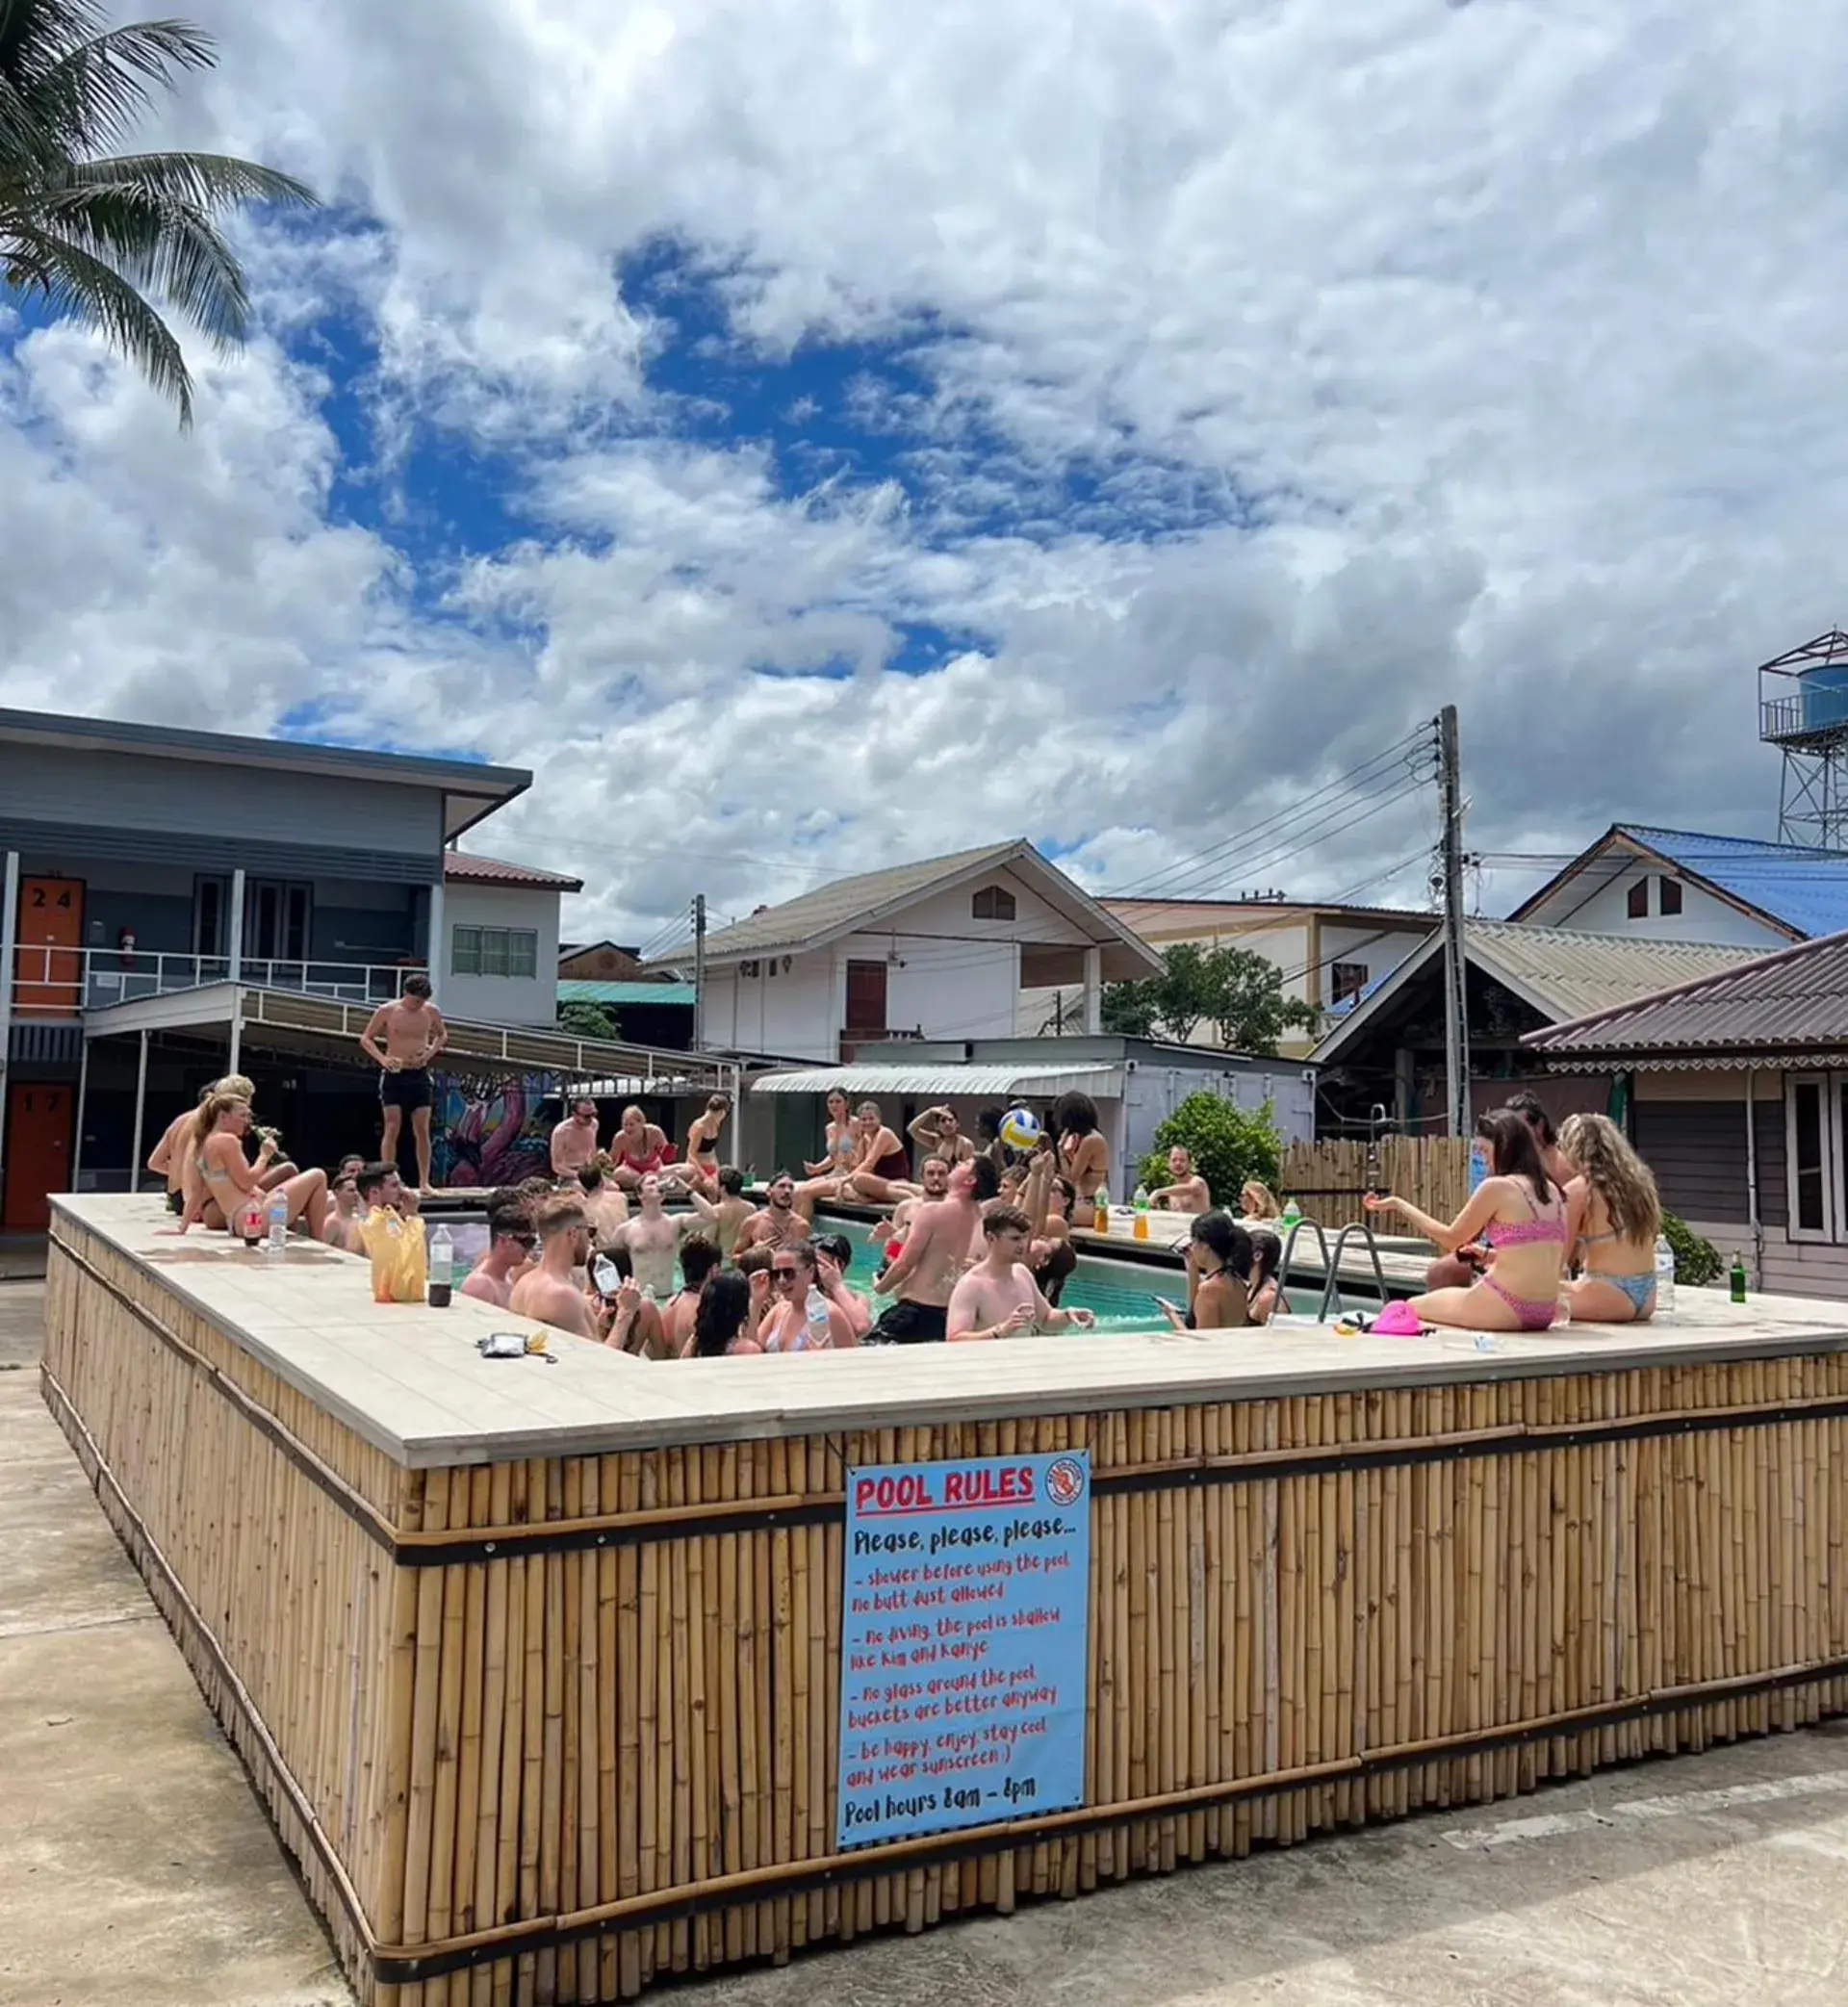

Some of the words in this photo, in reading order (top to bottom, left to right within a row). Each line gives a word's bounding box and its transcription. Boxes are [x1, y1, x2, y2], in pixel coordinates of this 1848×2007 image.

[856, 1474, 933, 1510] POOL
[944, 1466, 1034, 1504] RULES
[855, 1530, 925, 1556] Please,
[930, 1524, 998, 1556] please,
[1003, 1517, 1076, 1548] please...
[868, 1565, 916, 1587] shower
[922, 1562, 974, 1581] before
[977, 1558, 1013, 1579] using
[1015, 1555, 1040, 1573] the
[852, 1597, 870, 1613] no
[873, 1589, 909, 1611] butt
[913, 1585, 946, 1607] dust
[950, 1582, 1005, 1603] allowed
[865, 1629, 883, 1644] no
[937, 1617, 962, 1636] the
[966, 1614, 992, 1636] pool
[995, 1614, 1007, 1628] is
[1012, 1607, 1060, 1626] shallow
[849, 1654, 876, 1671] like
[911, 1646, 937, 1665] and
[862, 1685, 880, 1702] no
[885, 1682, 922, 1704] glass
[927, 1671, 977, 1694] around
[981, 1668, 1005, 1688] the
[848, 1705, 910, 1730] buckets
[914, 1700, 939, 1721] are
[944, 1691, 997, 1715] better
[1002, 1685, 1058, 1711] anyway
[860, 1740, 879, 1761] be
[983, 1723, 1017, 1745] stay
[1020, 1717, 1047, 1736] cool
[846, 1767, 874, 1788] and
[878, 1763, 916, 1783] wear
[921, 1750, 998, 1776] sunscreen
[845, 1799, 880, 1828] Pool
[886, 1792, 937, 1820] hours
[943, 1787, 980, 1810] 8am
